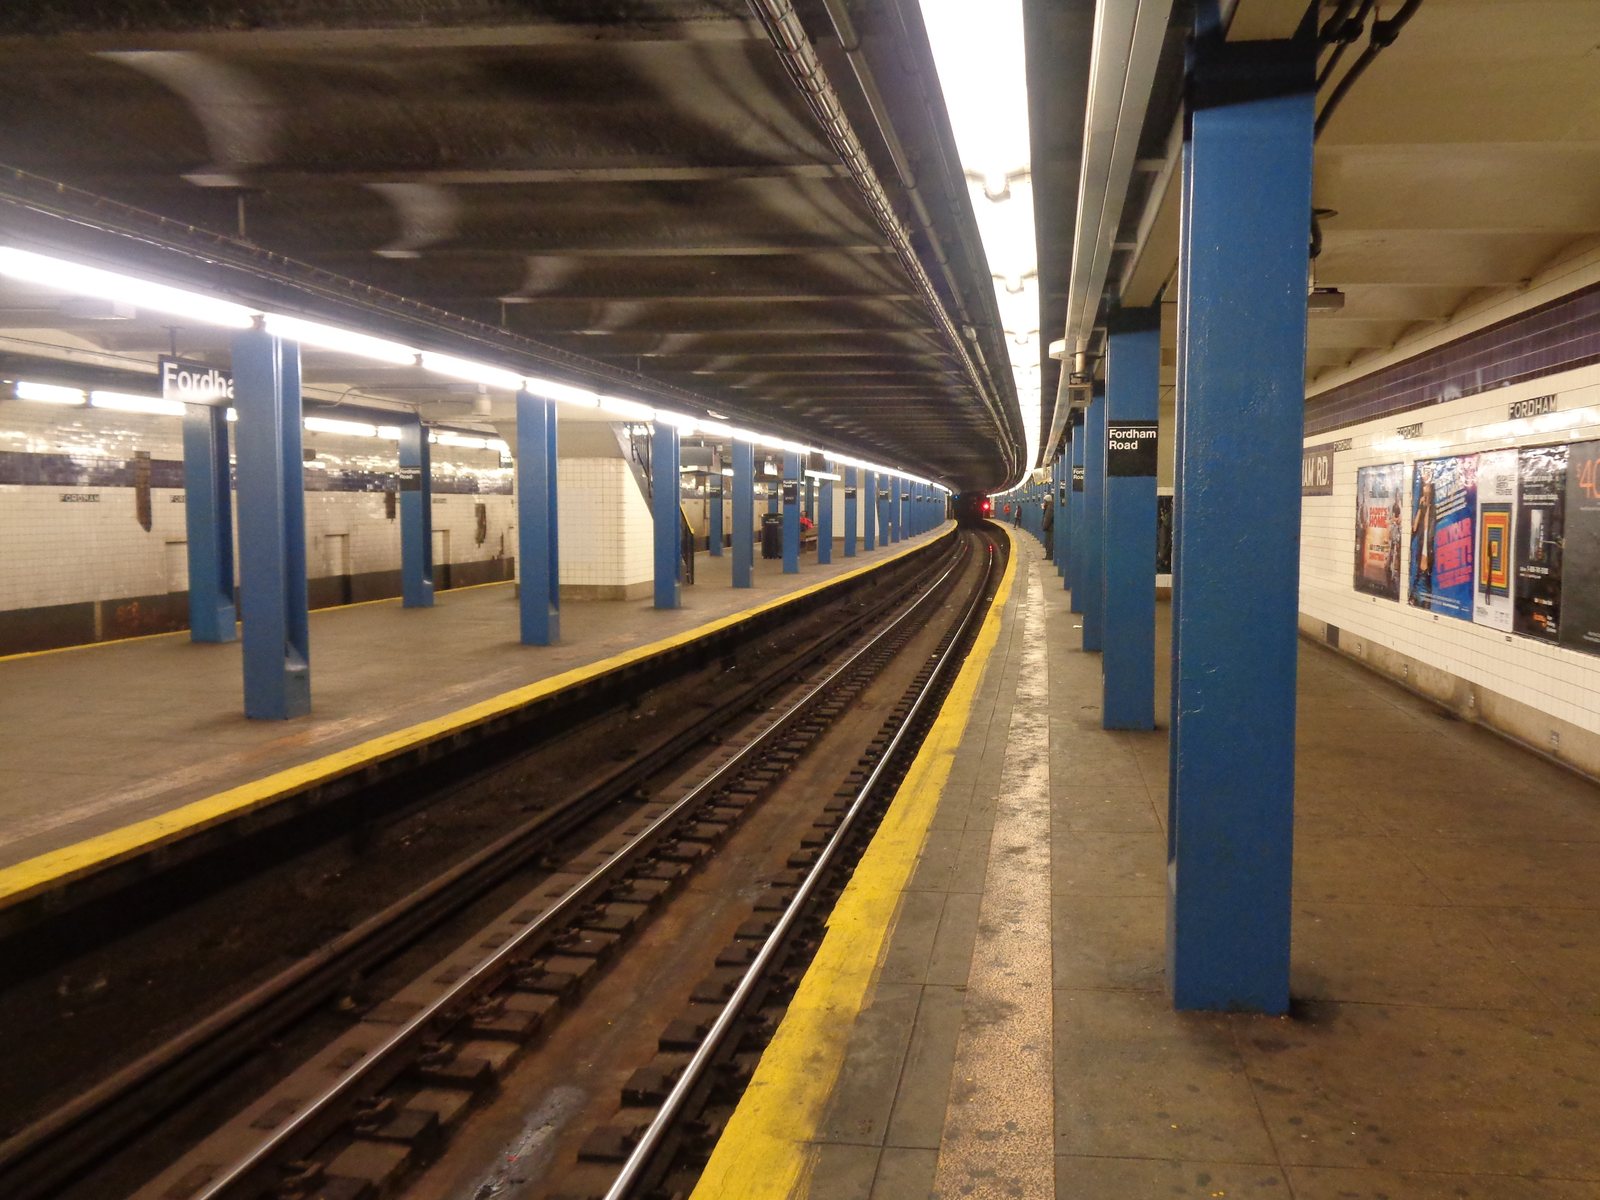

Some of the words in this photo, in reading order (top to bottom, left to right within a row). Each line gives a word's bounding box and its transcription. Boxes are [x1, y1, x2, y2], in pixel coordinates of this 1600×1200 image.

[1508, 394, 1557, 419] FORDHAM
[1109, 429, 1157, 439] Fordham
[1109, 440, 1138, 450] Road
